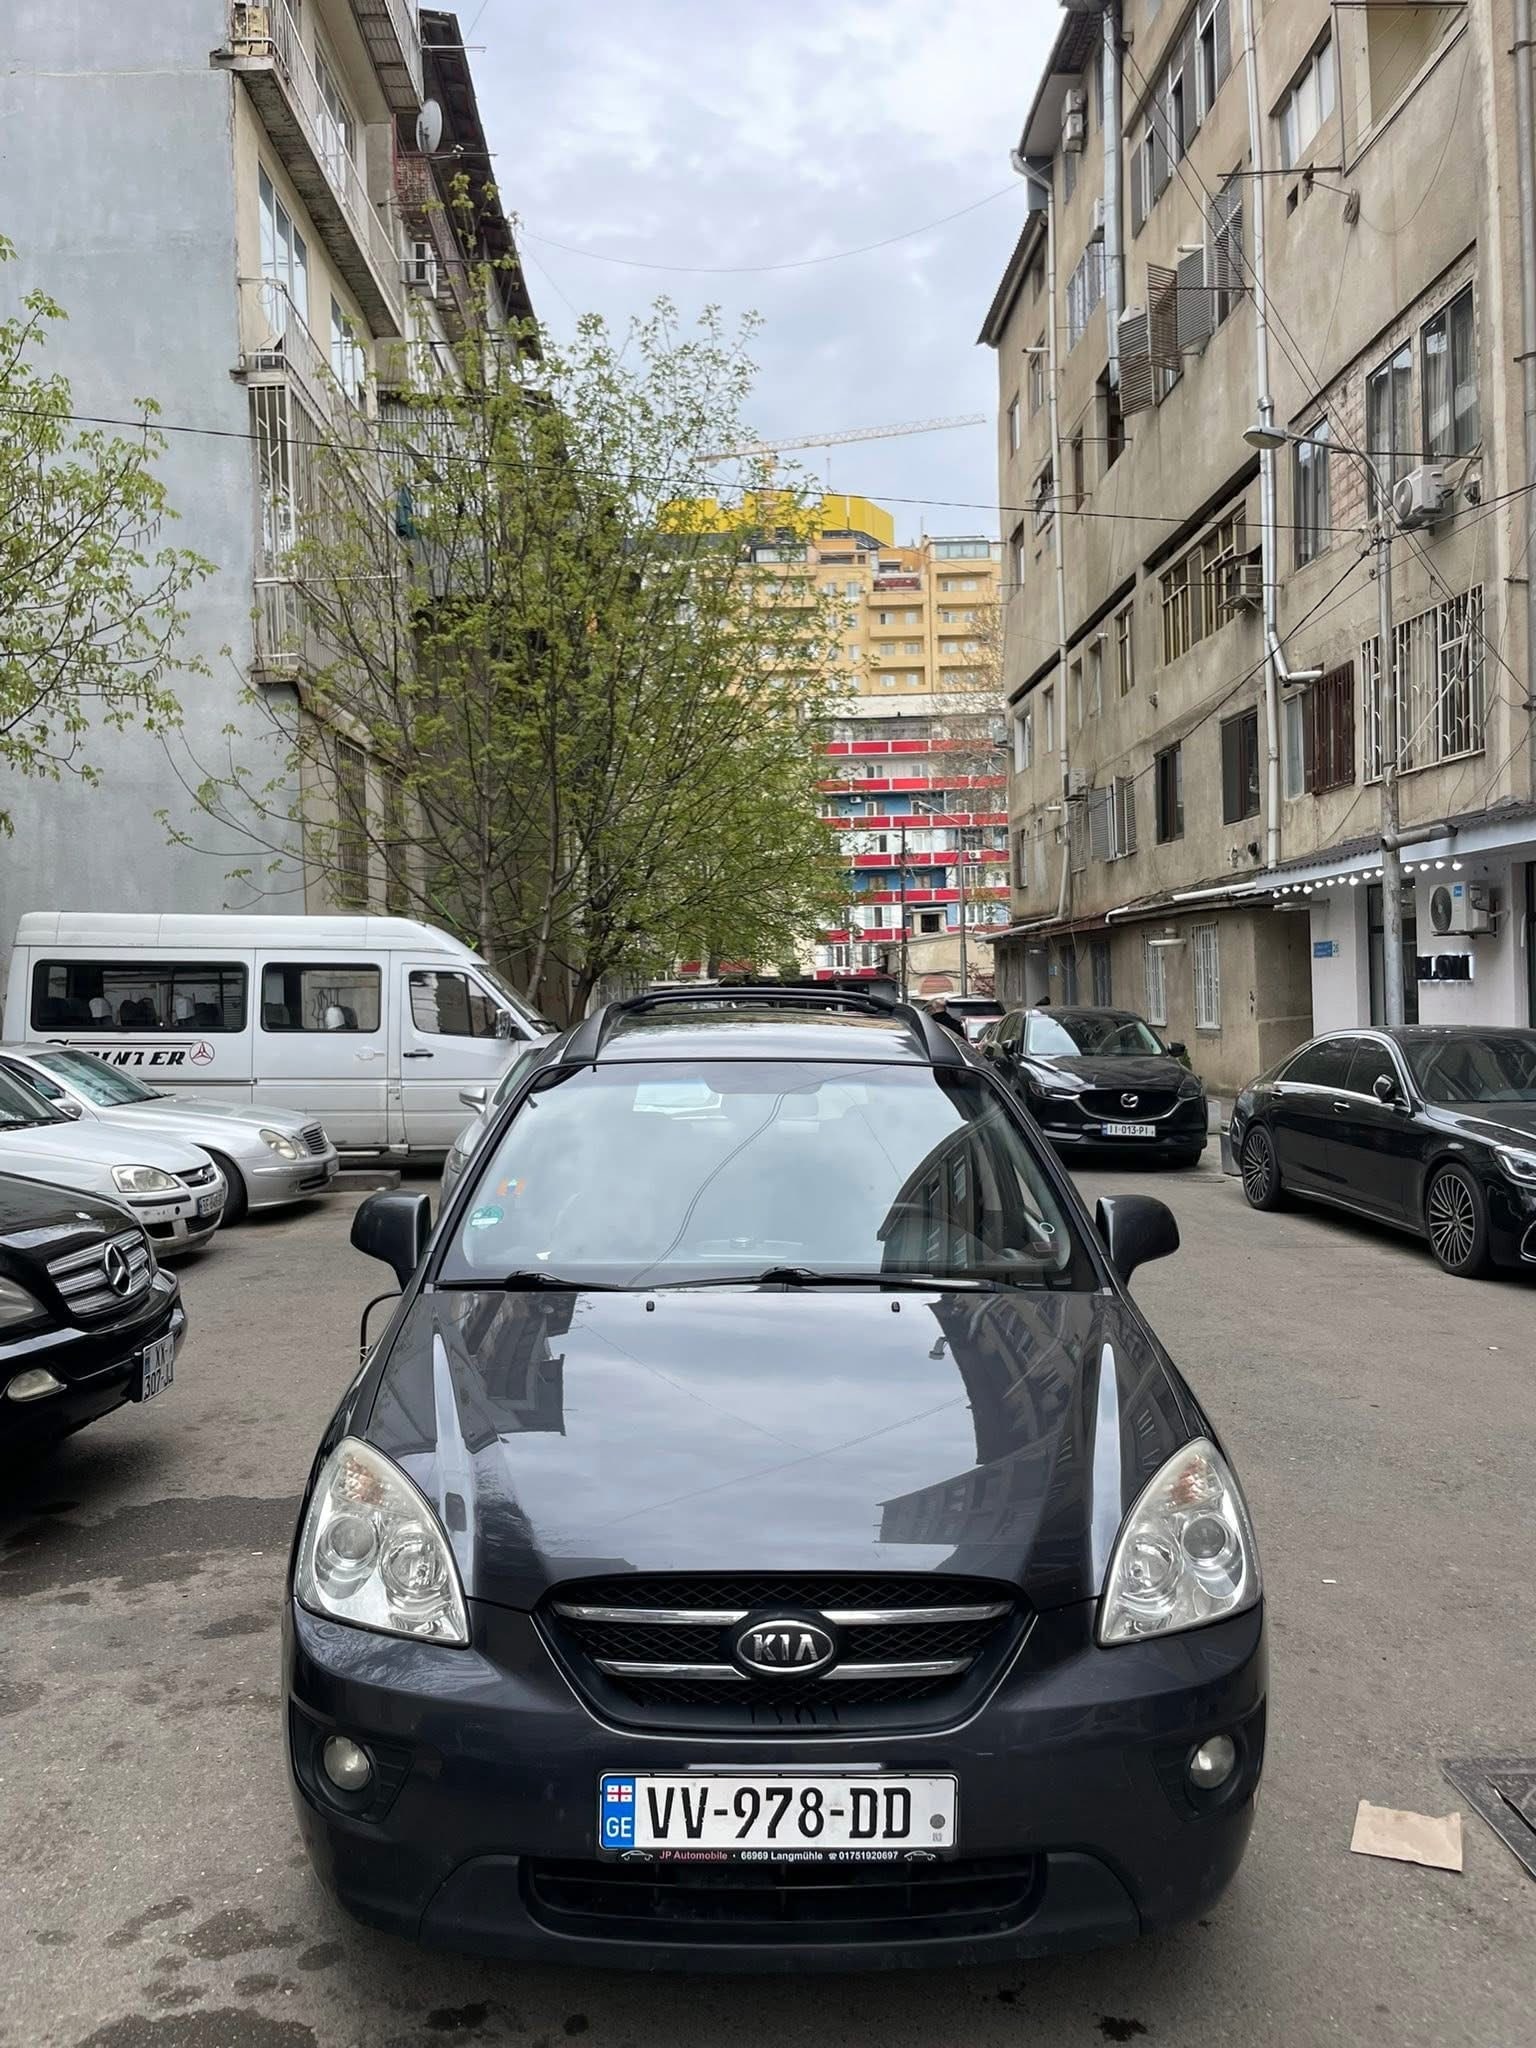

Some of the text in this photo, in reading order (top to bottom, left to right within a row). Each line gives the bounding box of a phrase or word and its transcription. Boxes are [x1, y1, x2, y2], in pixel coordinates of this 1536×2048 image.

[752, 1633, 819, 1661] KIA
[606, 1786, 911, 1839] GE VV-978-DD
[659, 1850, 671, 1860] JP
[673, 1850, 728, 1860] Automobile
[740, 1851, 769, 1861] 66969
[771, 1850, 823, 1862] Langmühle
